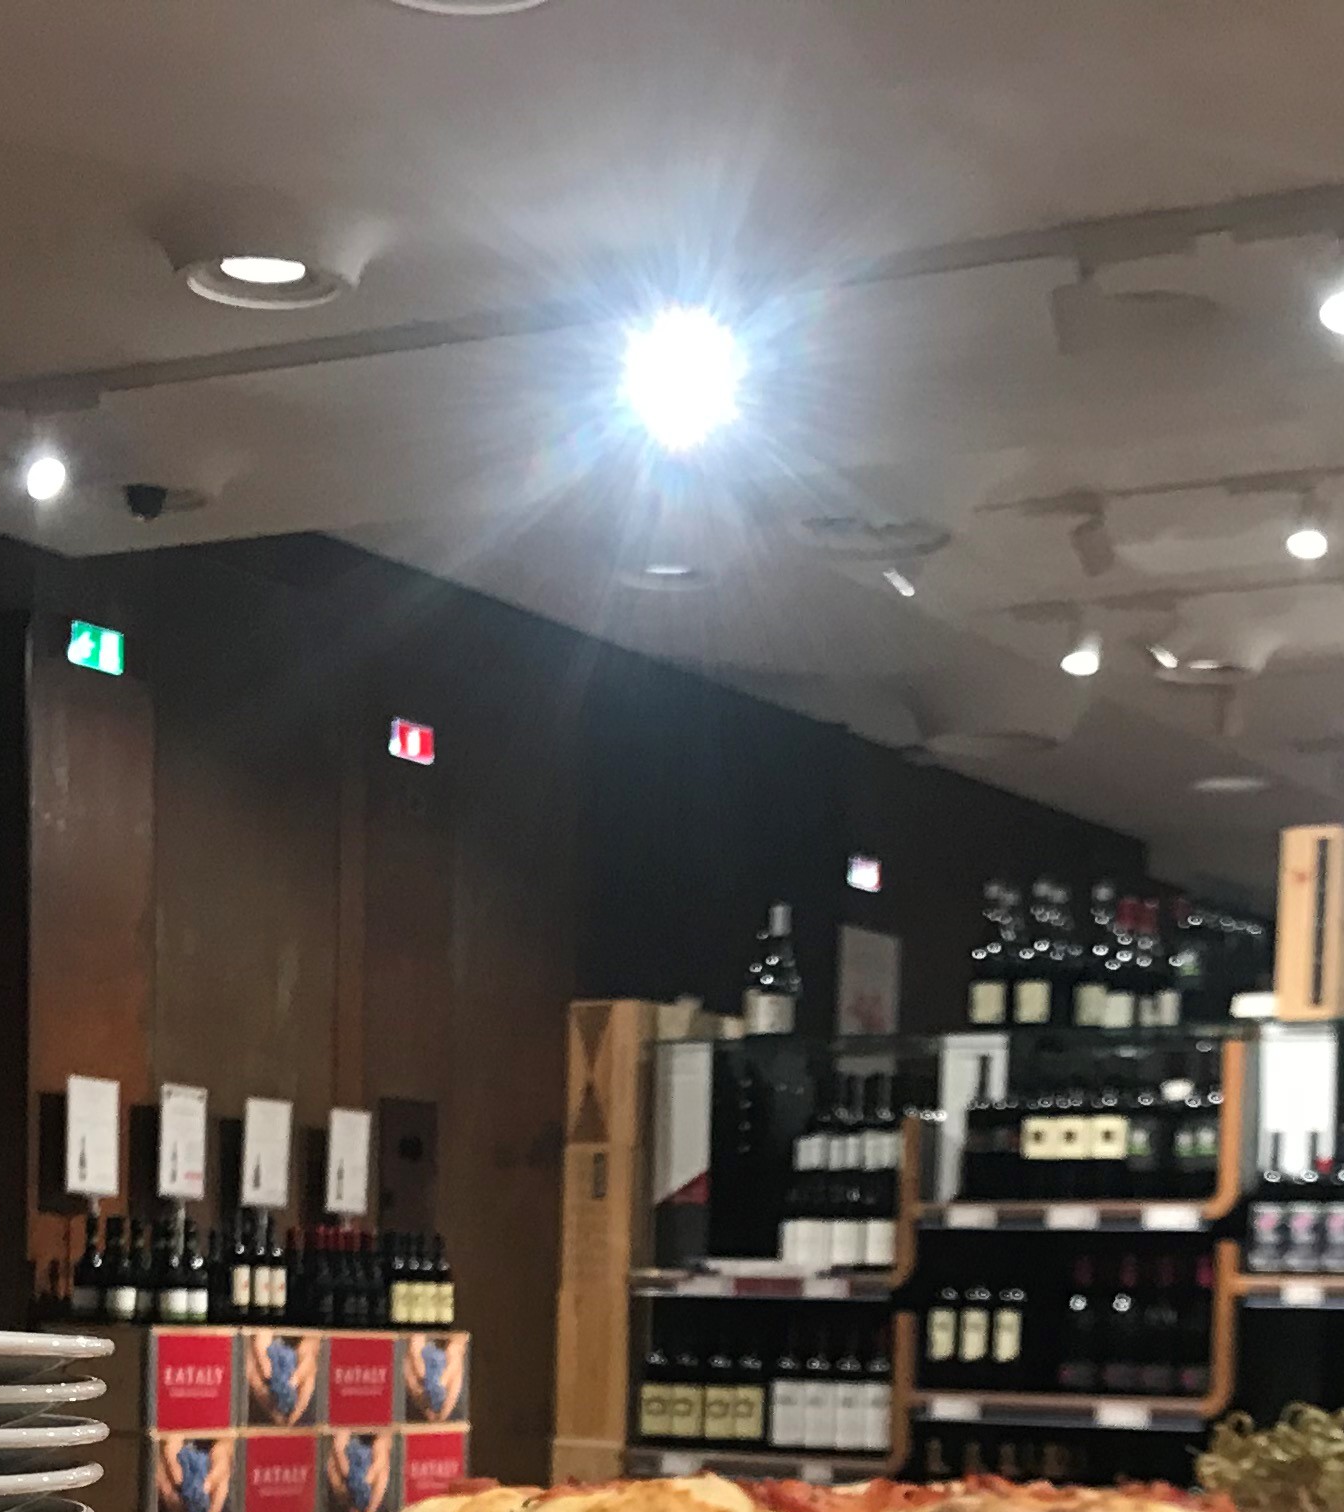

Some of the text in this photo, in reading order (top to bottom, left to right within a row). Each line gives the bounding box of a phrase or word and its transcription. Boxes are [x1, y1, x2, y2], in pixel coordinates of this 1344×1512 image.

[164, 1363, 225, 1386] EATALY
[334, 1364, 388, 1385] EATALY
[252, 1465, 309, 1488] EATALY
